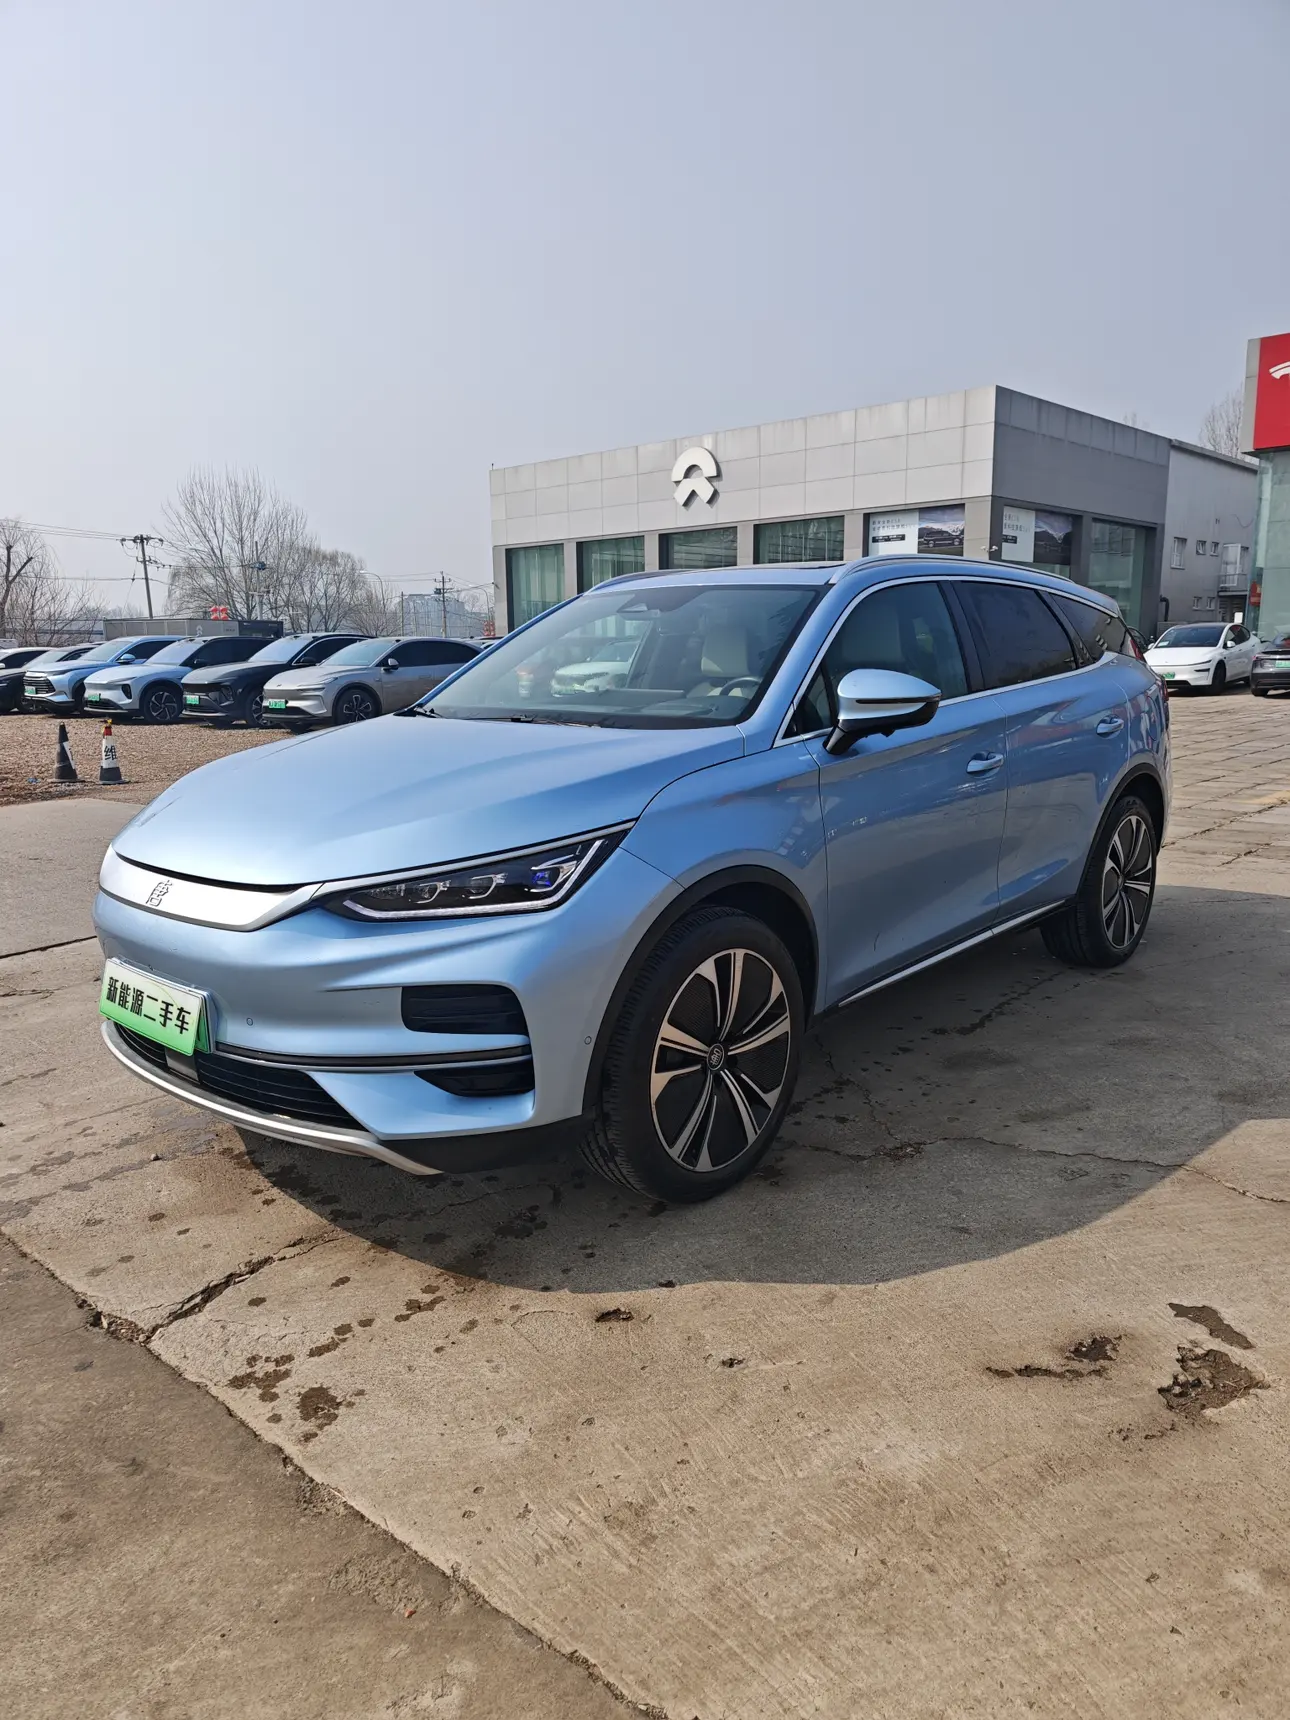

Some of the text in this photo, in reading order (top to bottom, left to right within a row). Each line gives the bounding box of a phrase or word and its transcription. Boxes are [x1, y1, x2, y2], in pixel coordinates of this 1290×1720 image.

[106, 976, 192, 1035] 新能源二手车
